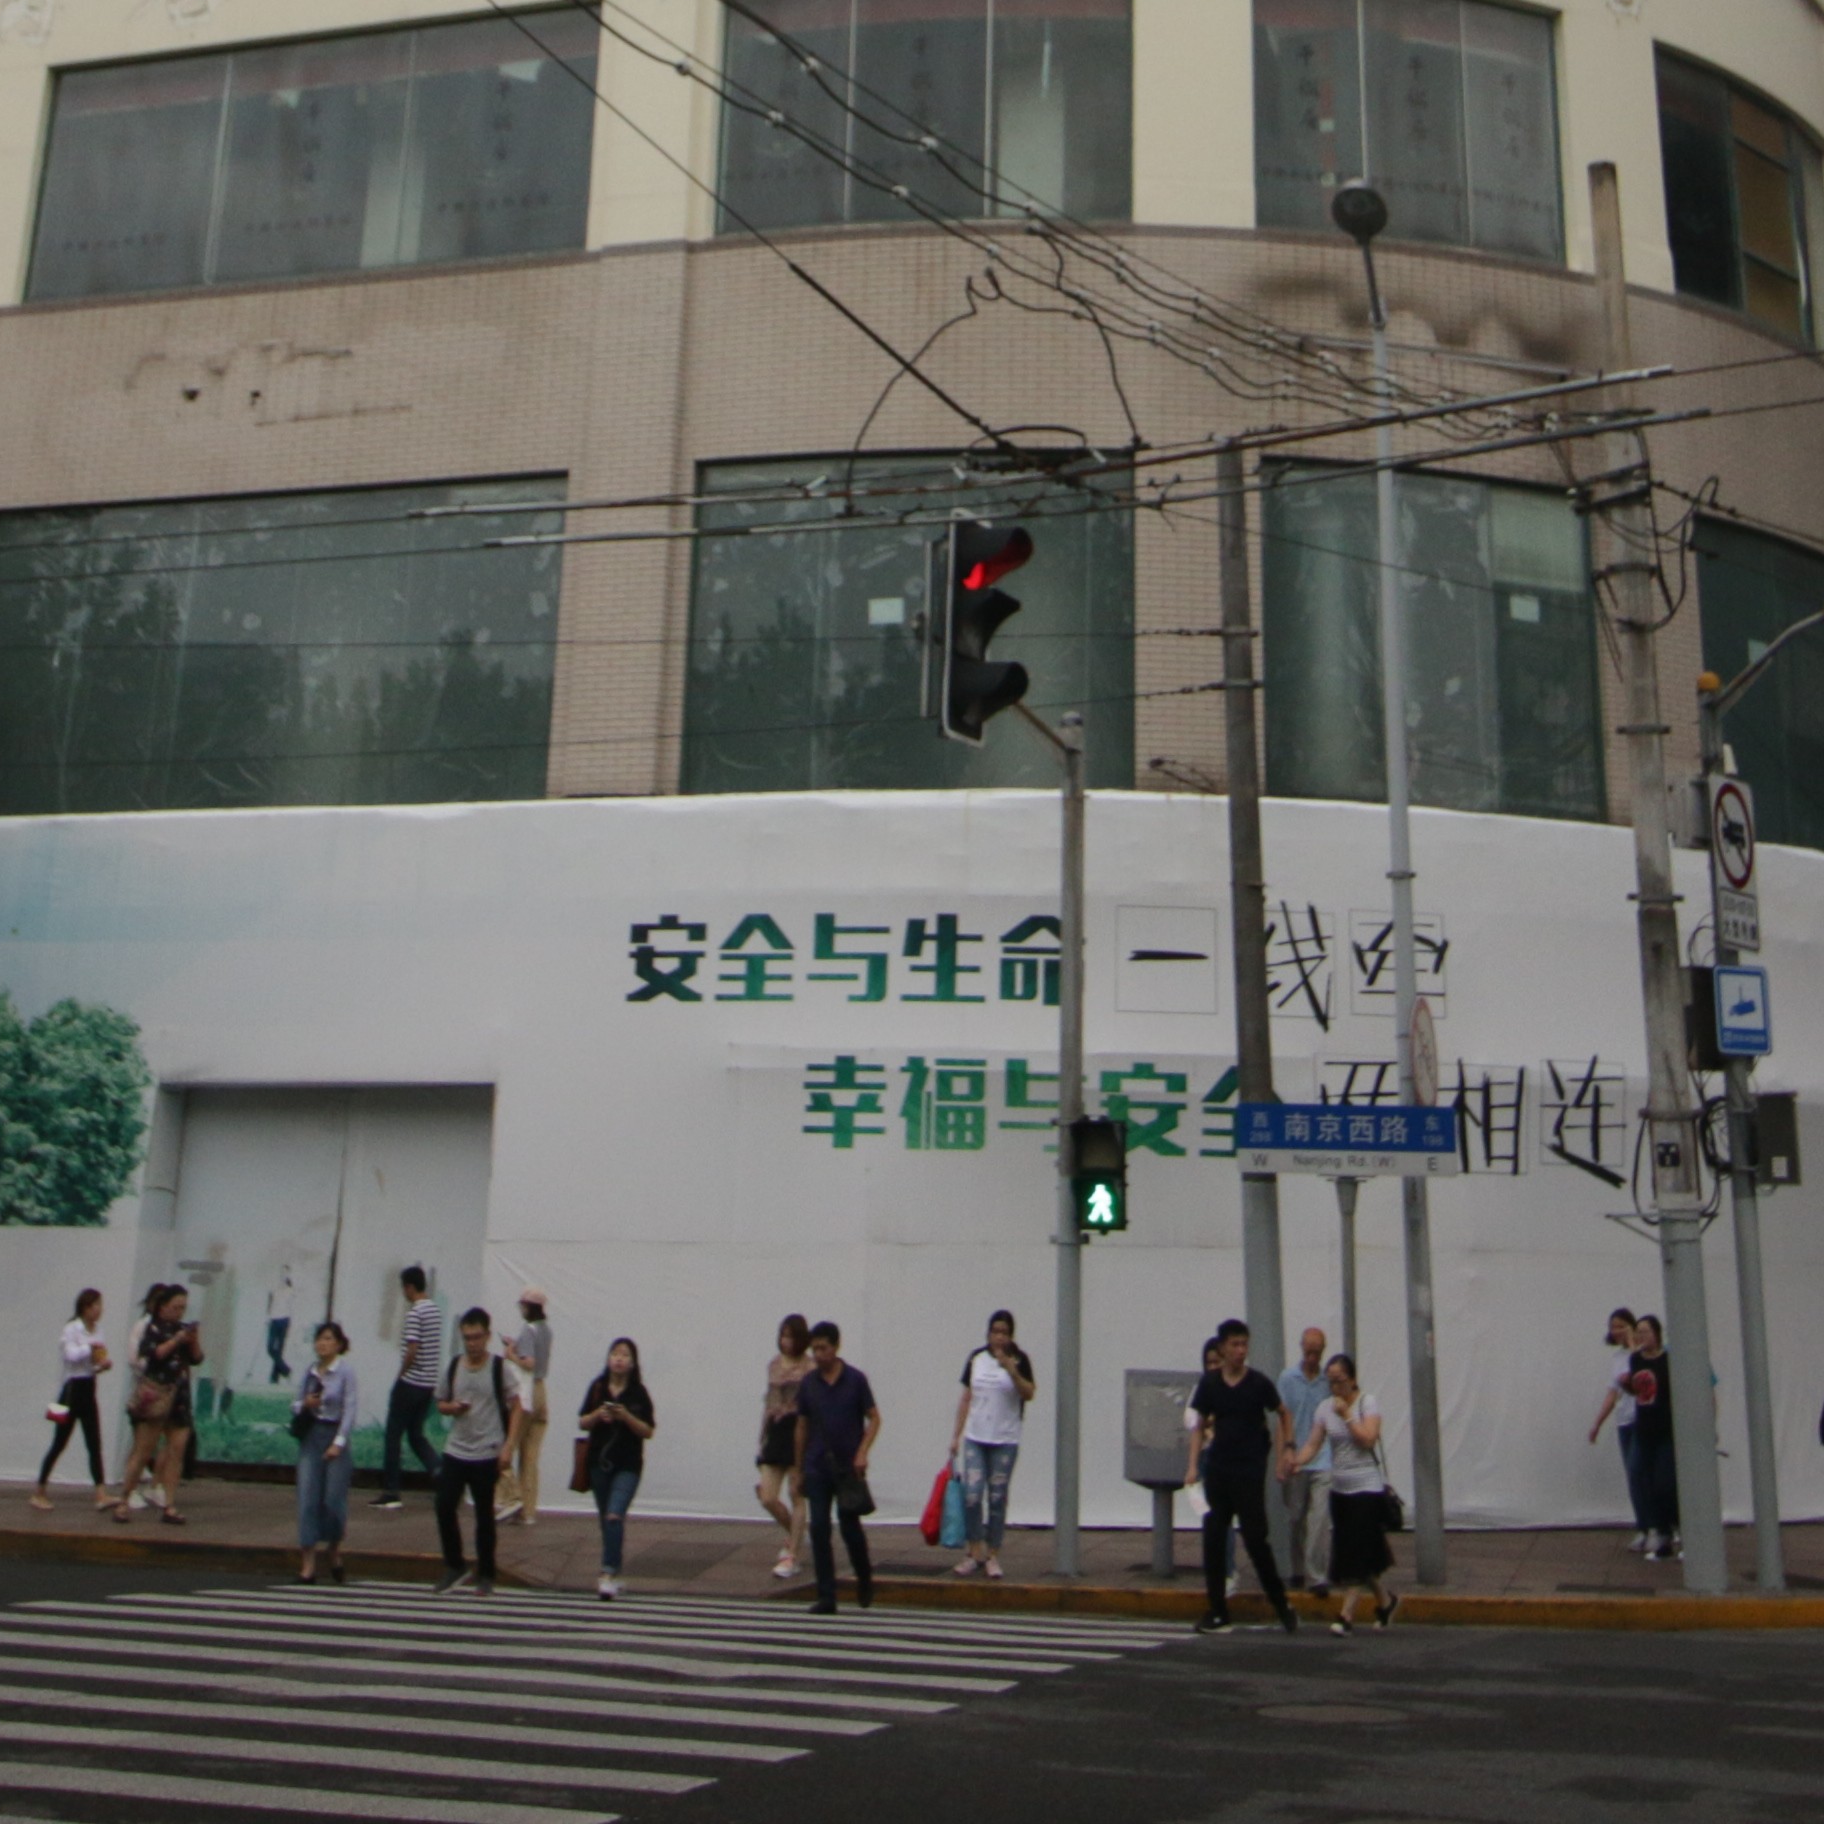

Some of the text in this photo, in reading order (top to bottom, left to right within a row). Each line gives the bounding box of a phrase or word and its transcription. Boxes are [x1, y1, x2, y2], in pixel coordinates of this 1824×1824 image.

[625, 914, 1060, 1005] 安全与生命
[1284, 1113, 1408, 1144] 南京西路
[1252, 1154, 1268, 1167] W
[1293, 1154, 1342, 1169] Nanjing
[1426, 1158, 1438, 1171] E
